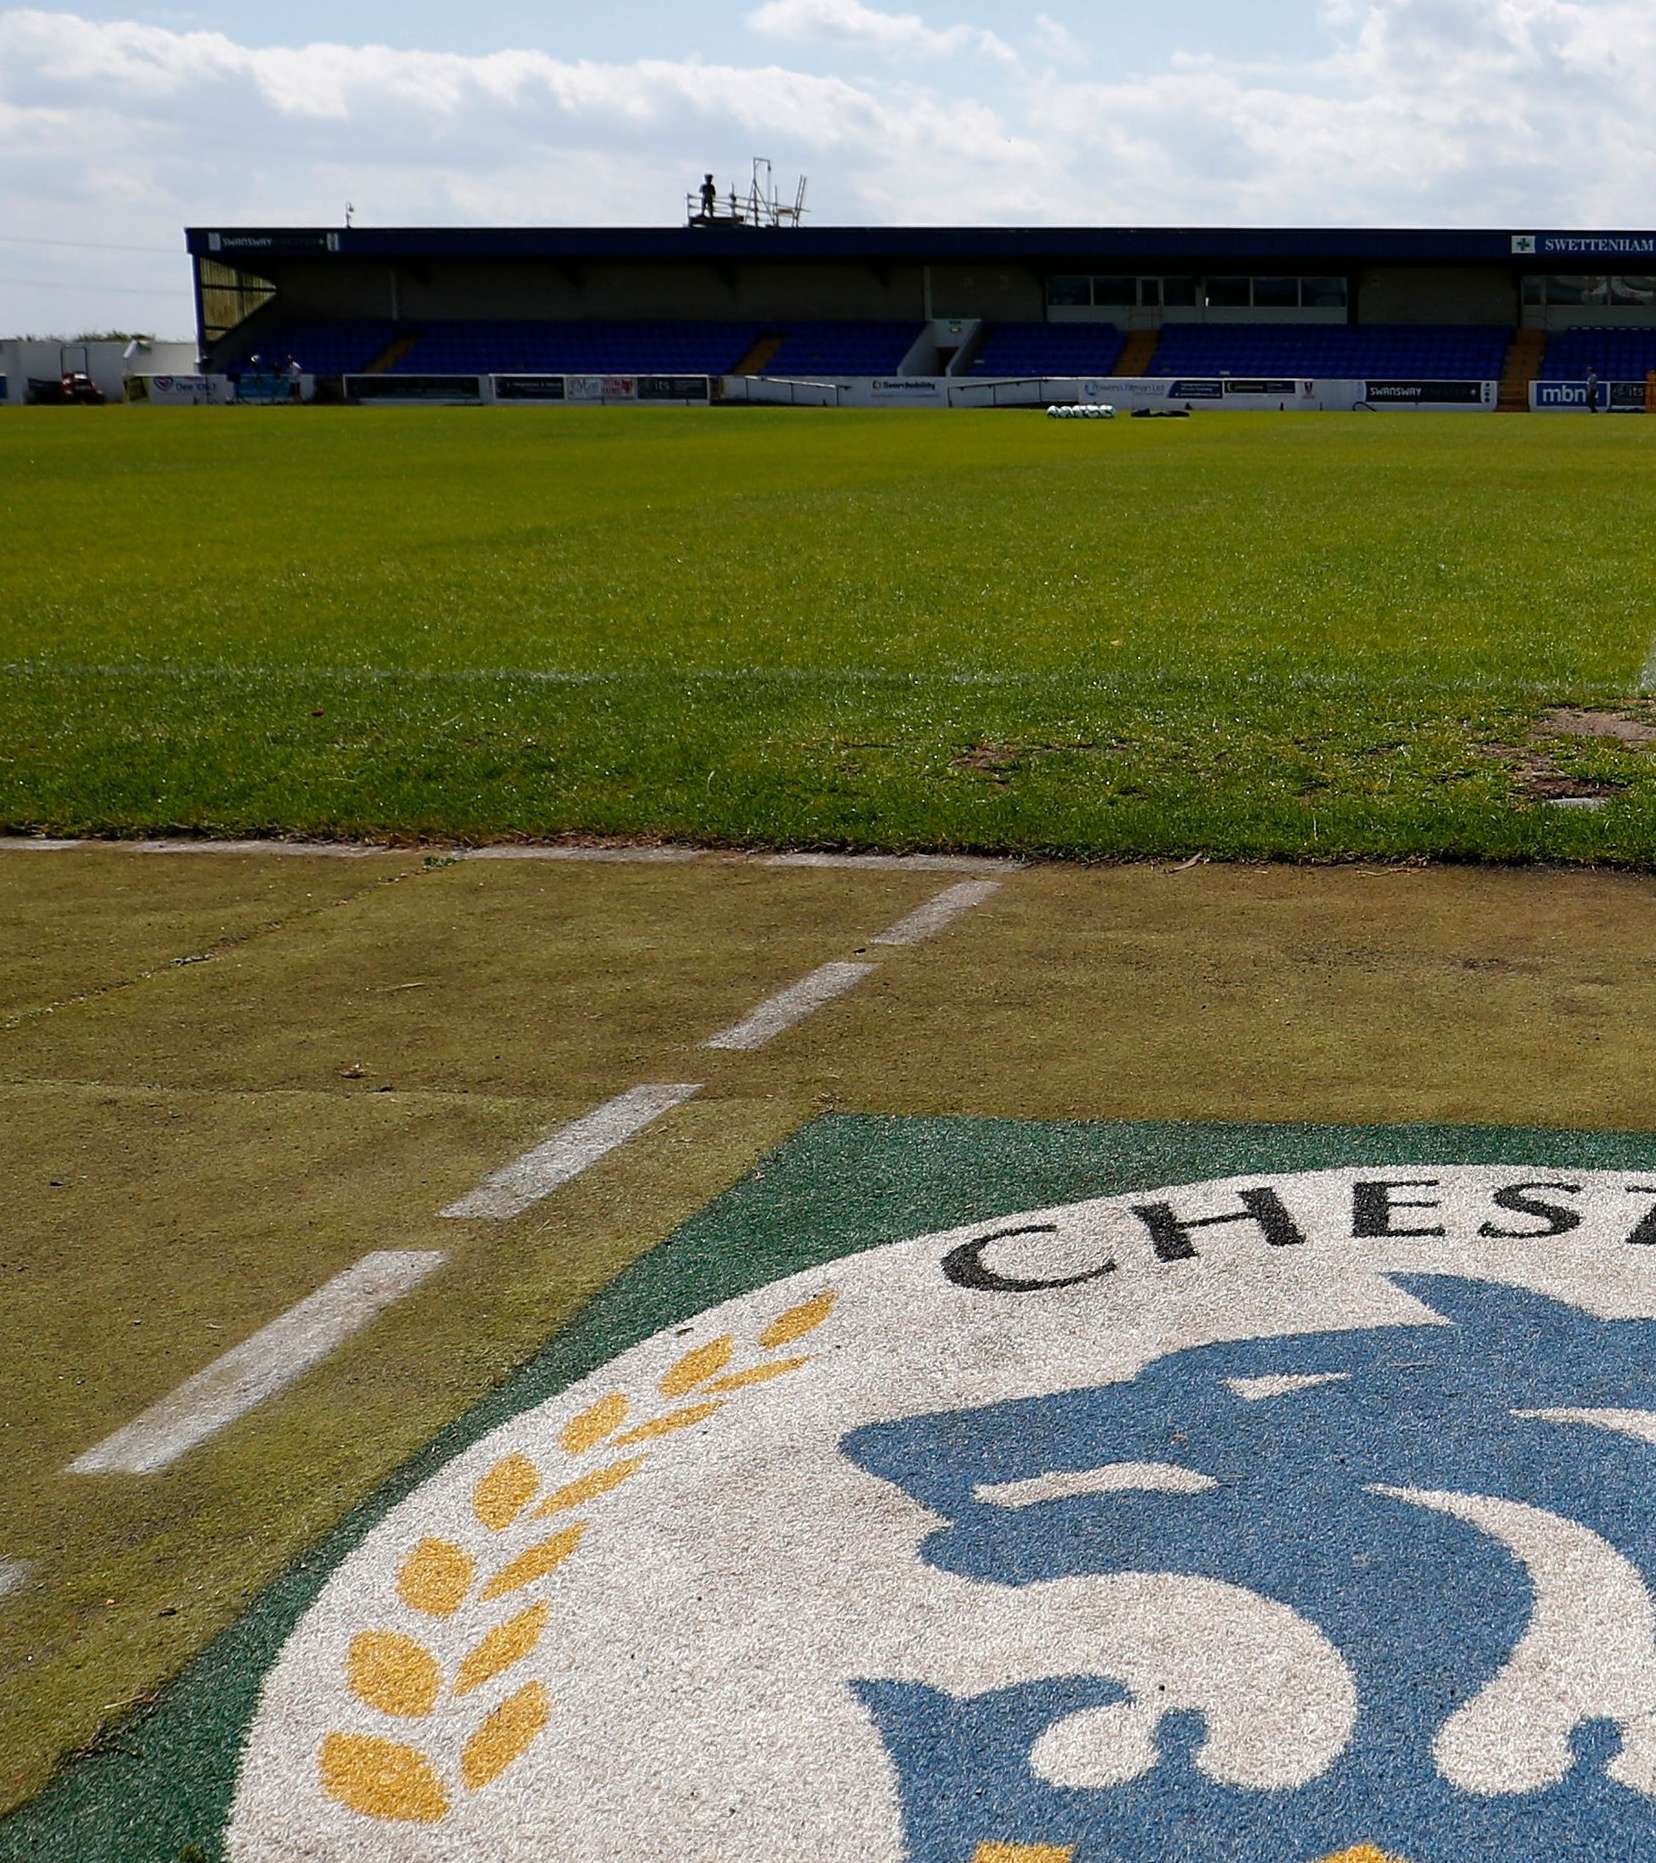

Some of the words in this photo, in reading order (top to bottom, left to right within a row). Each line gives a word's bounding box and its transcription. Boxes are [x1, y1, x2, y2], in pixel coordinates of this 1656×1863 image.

[222, 237, 273, 249] SWANSWAY
[1545, 238, 1654, 252] SWETTENHAM
[1370, 387, 1422, 397] SWANSWAY
[1542, 385, 1586, 402] mbn
